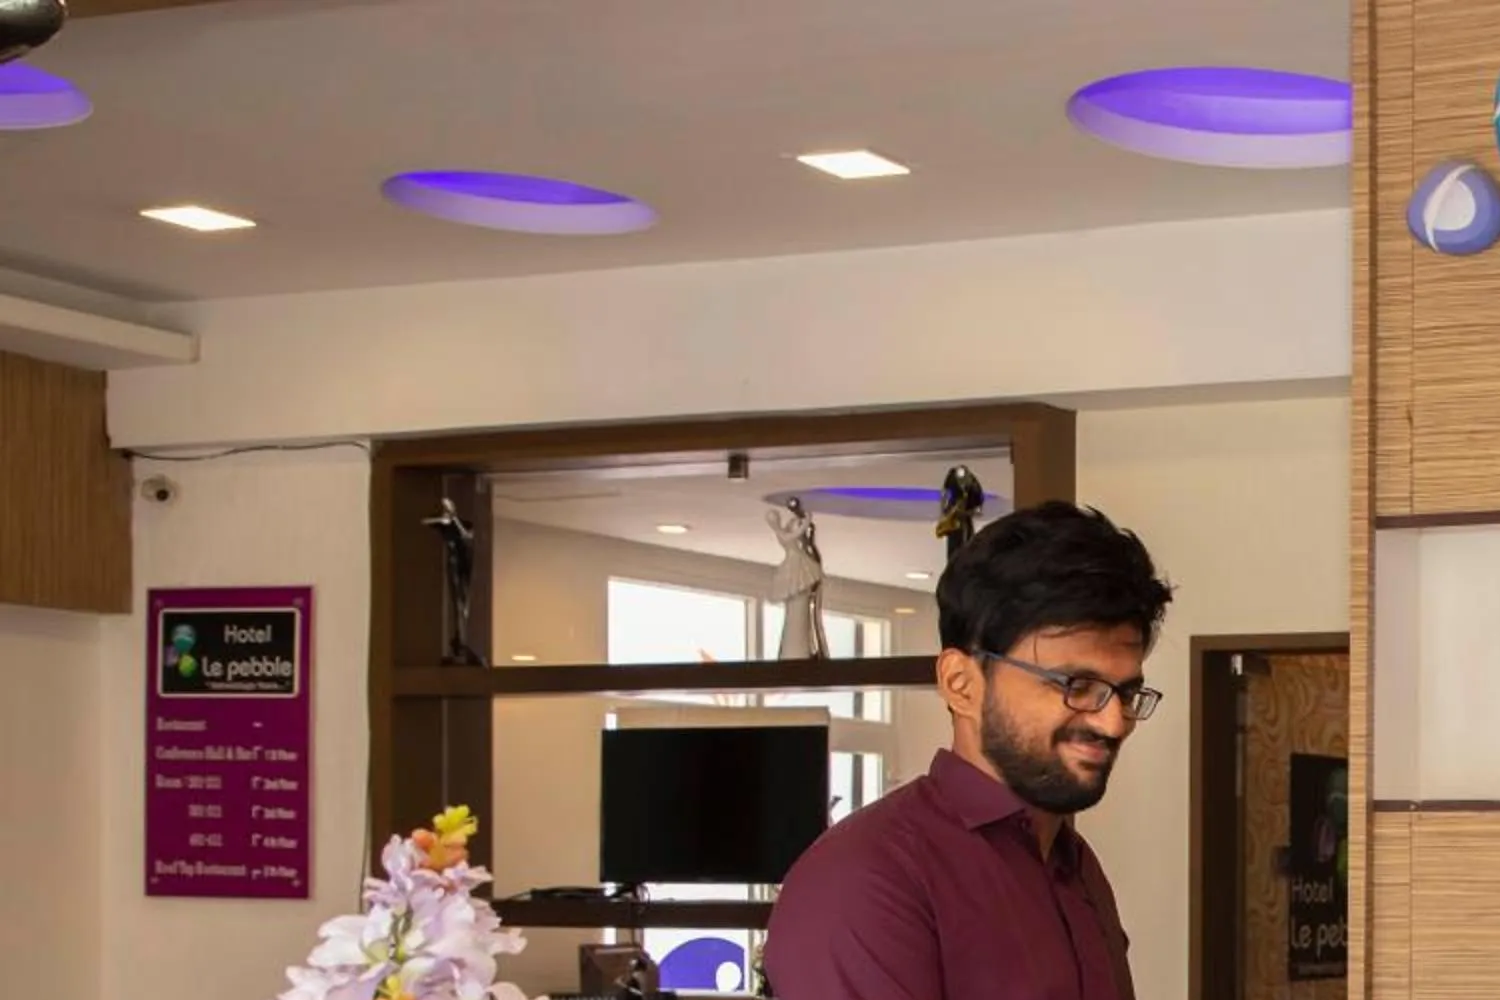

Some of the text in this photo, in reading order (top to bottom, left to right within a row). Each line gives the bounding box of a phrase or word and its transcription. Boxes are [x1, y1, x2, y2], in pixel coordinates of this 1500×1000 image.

[223, 624, 272, 644] Hotel
[226, 655, 292, 681] pebble
[1292, 876, 1334, 904] Hotel
